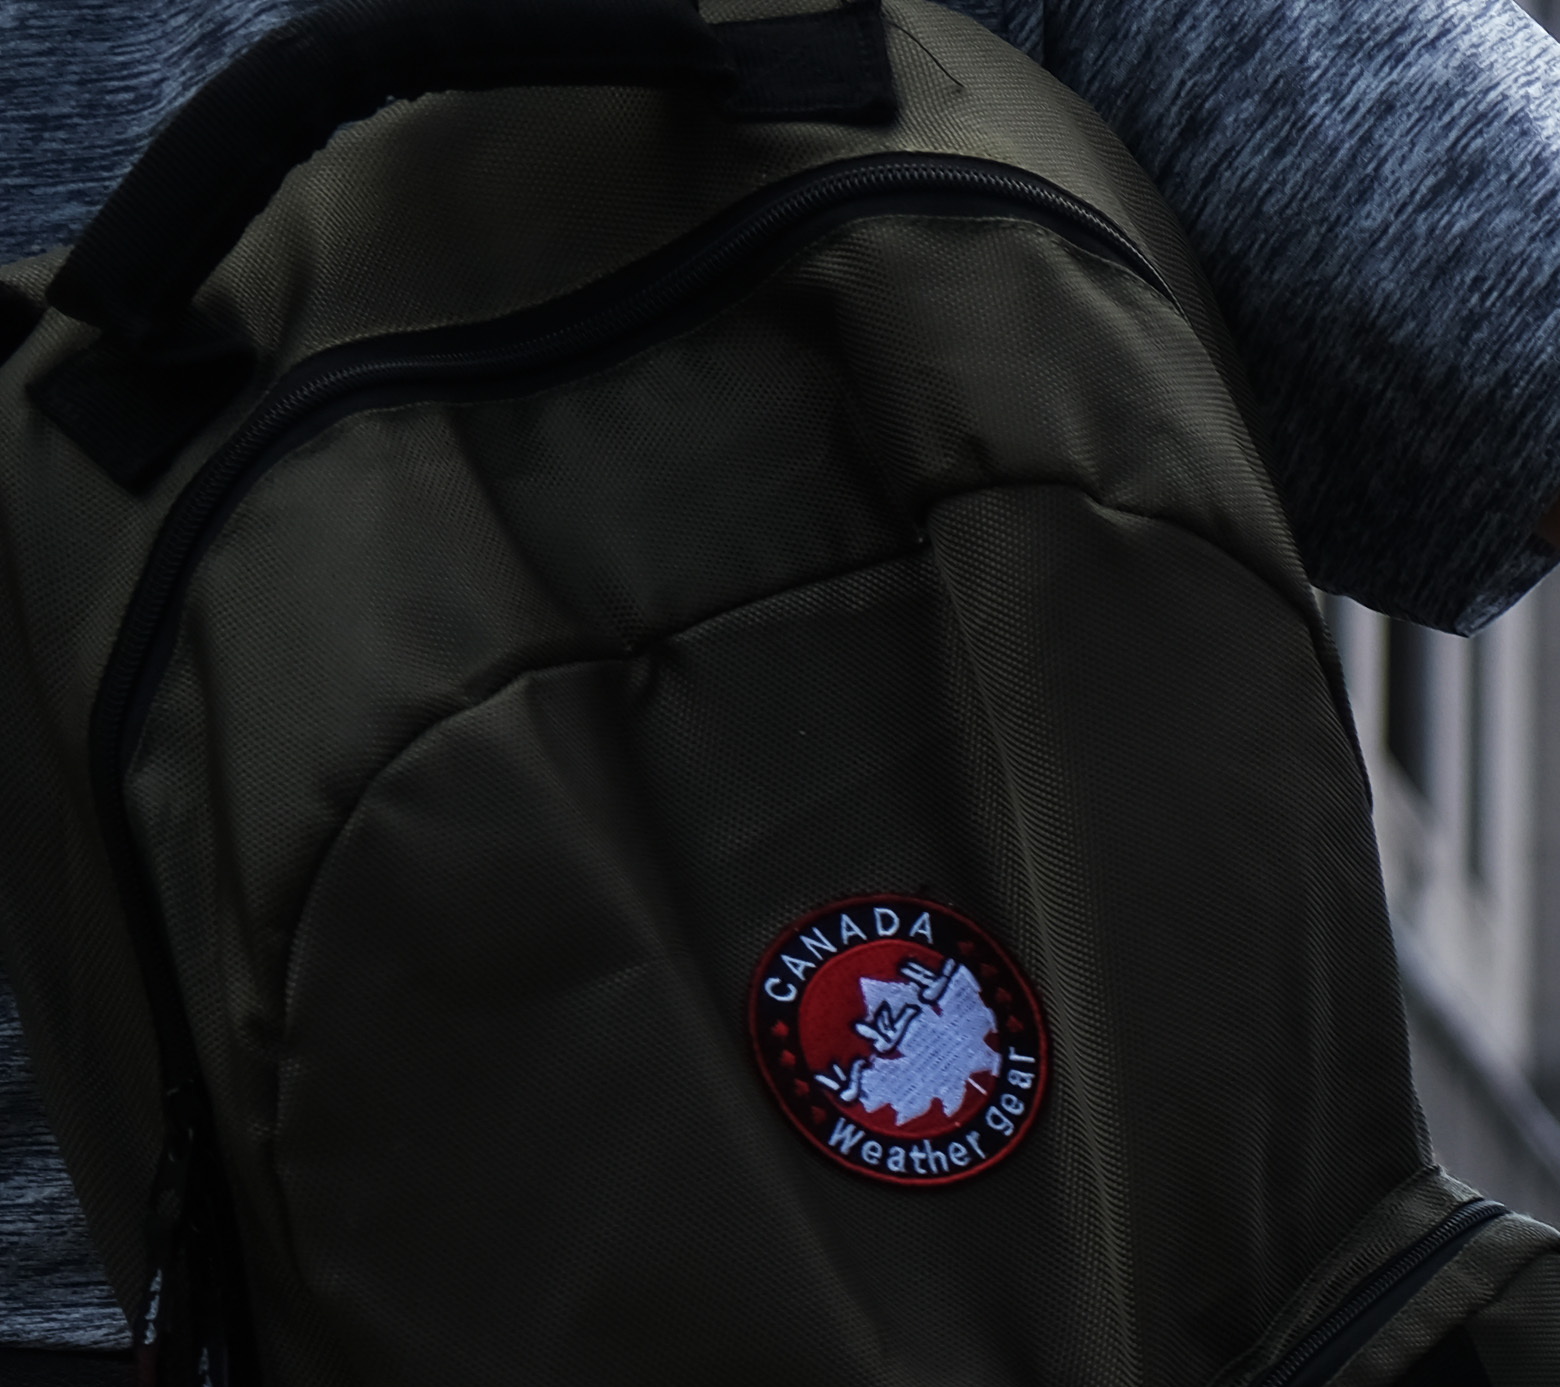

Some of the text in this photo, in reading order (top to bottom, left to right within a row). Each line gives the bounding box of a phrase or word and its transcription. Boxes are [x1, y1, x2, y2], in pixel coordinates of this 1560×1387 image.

[764, 907, 934, 1003] CANADA
[828, 1045, 1036, 1175] Weather gear
